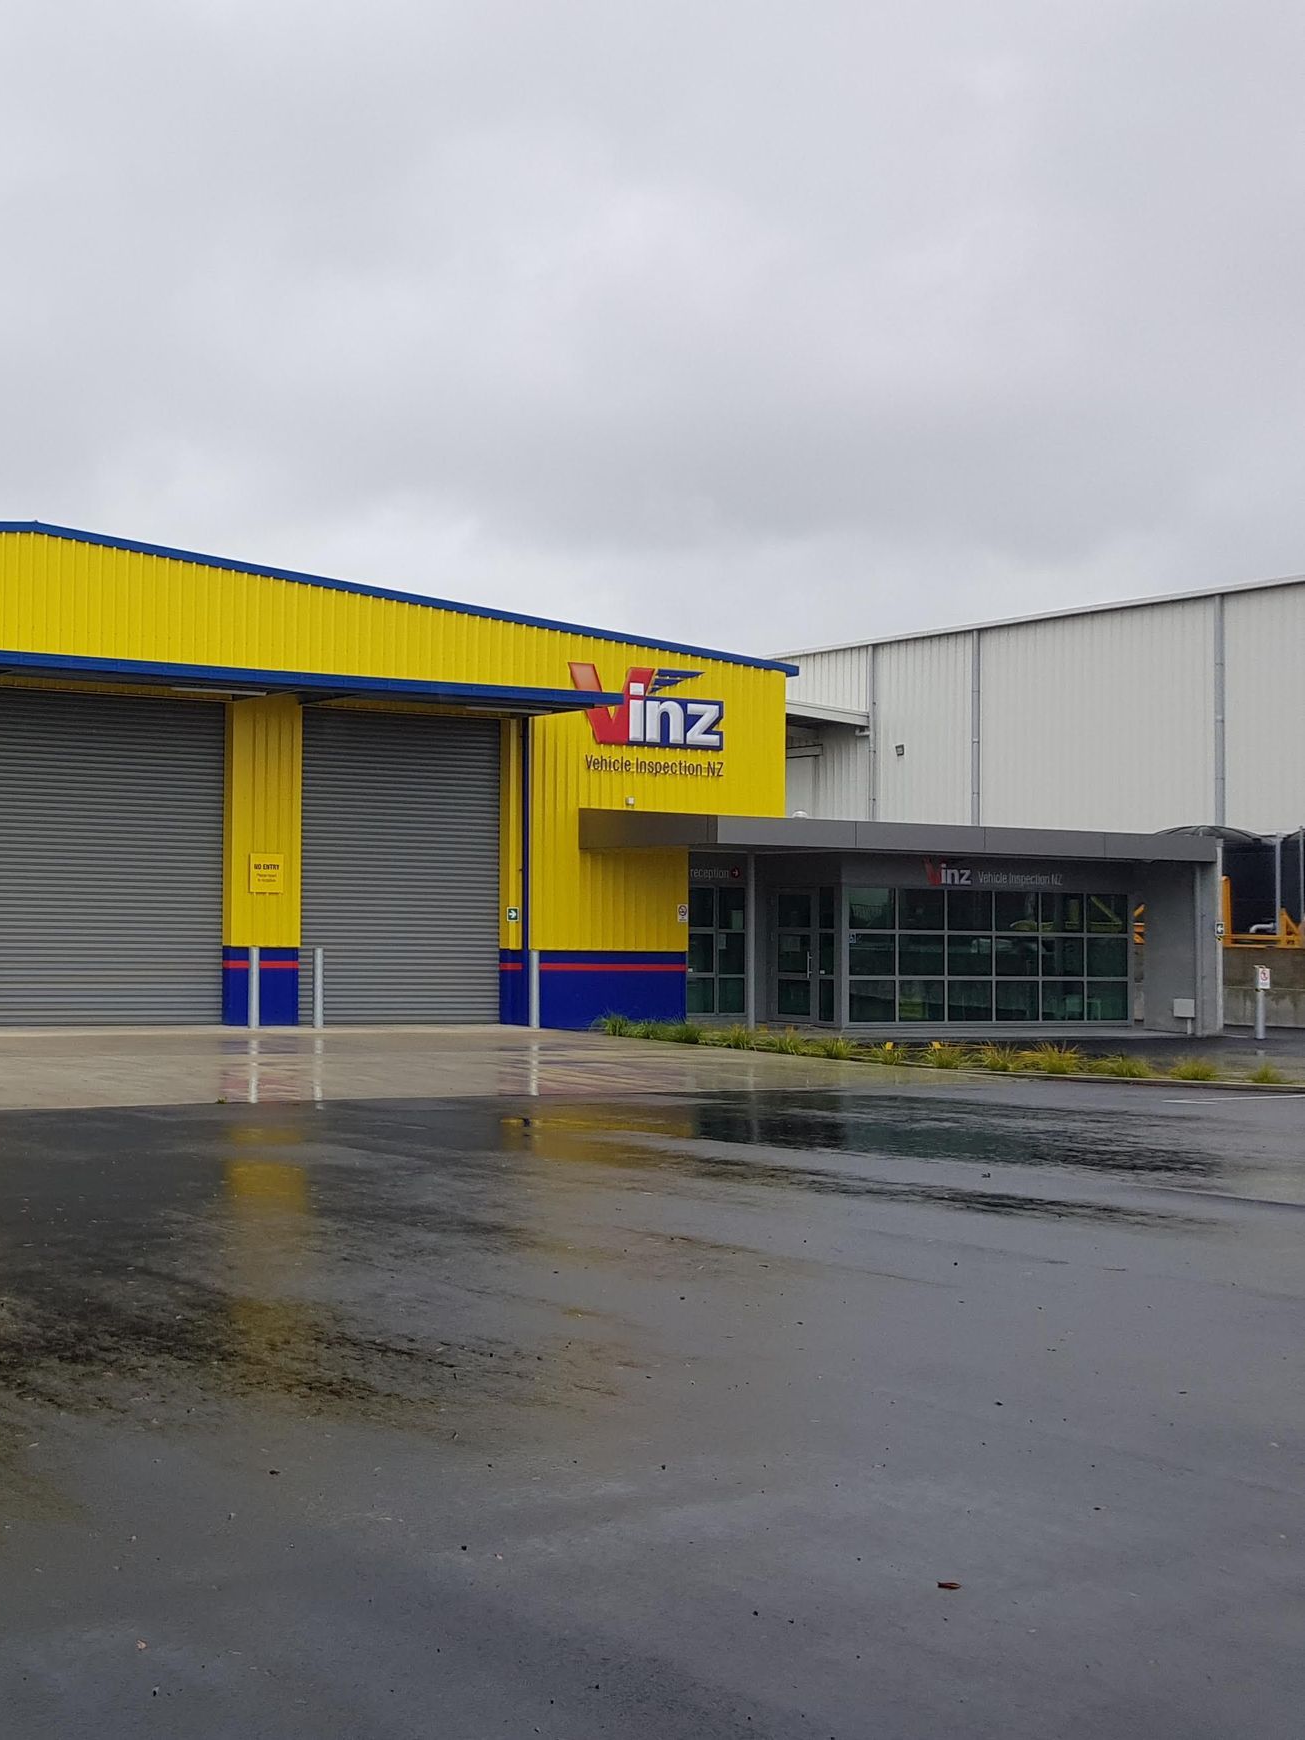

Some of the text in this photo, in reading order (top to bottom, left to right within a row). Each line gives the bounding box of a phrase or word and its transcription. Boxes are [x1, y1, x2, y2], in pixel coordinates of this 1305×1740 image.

[585, 754, 724, 777] Vehicle Inspection NZ
[690, 866, 729, 880] reception
[978, 871, 1063, 887] Vehicle Inspection NZ
